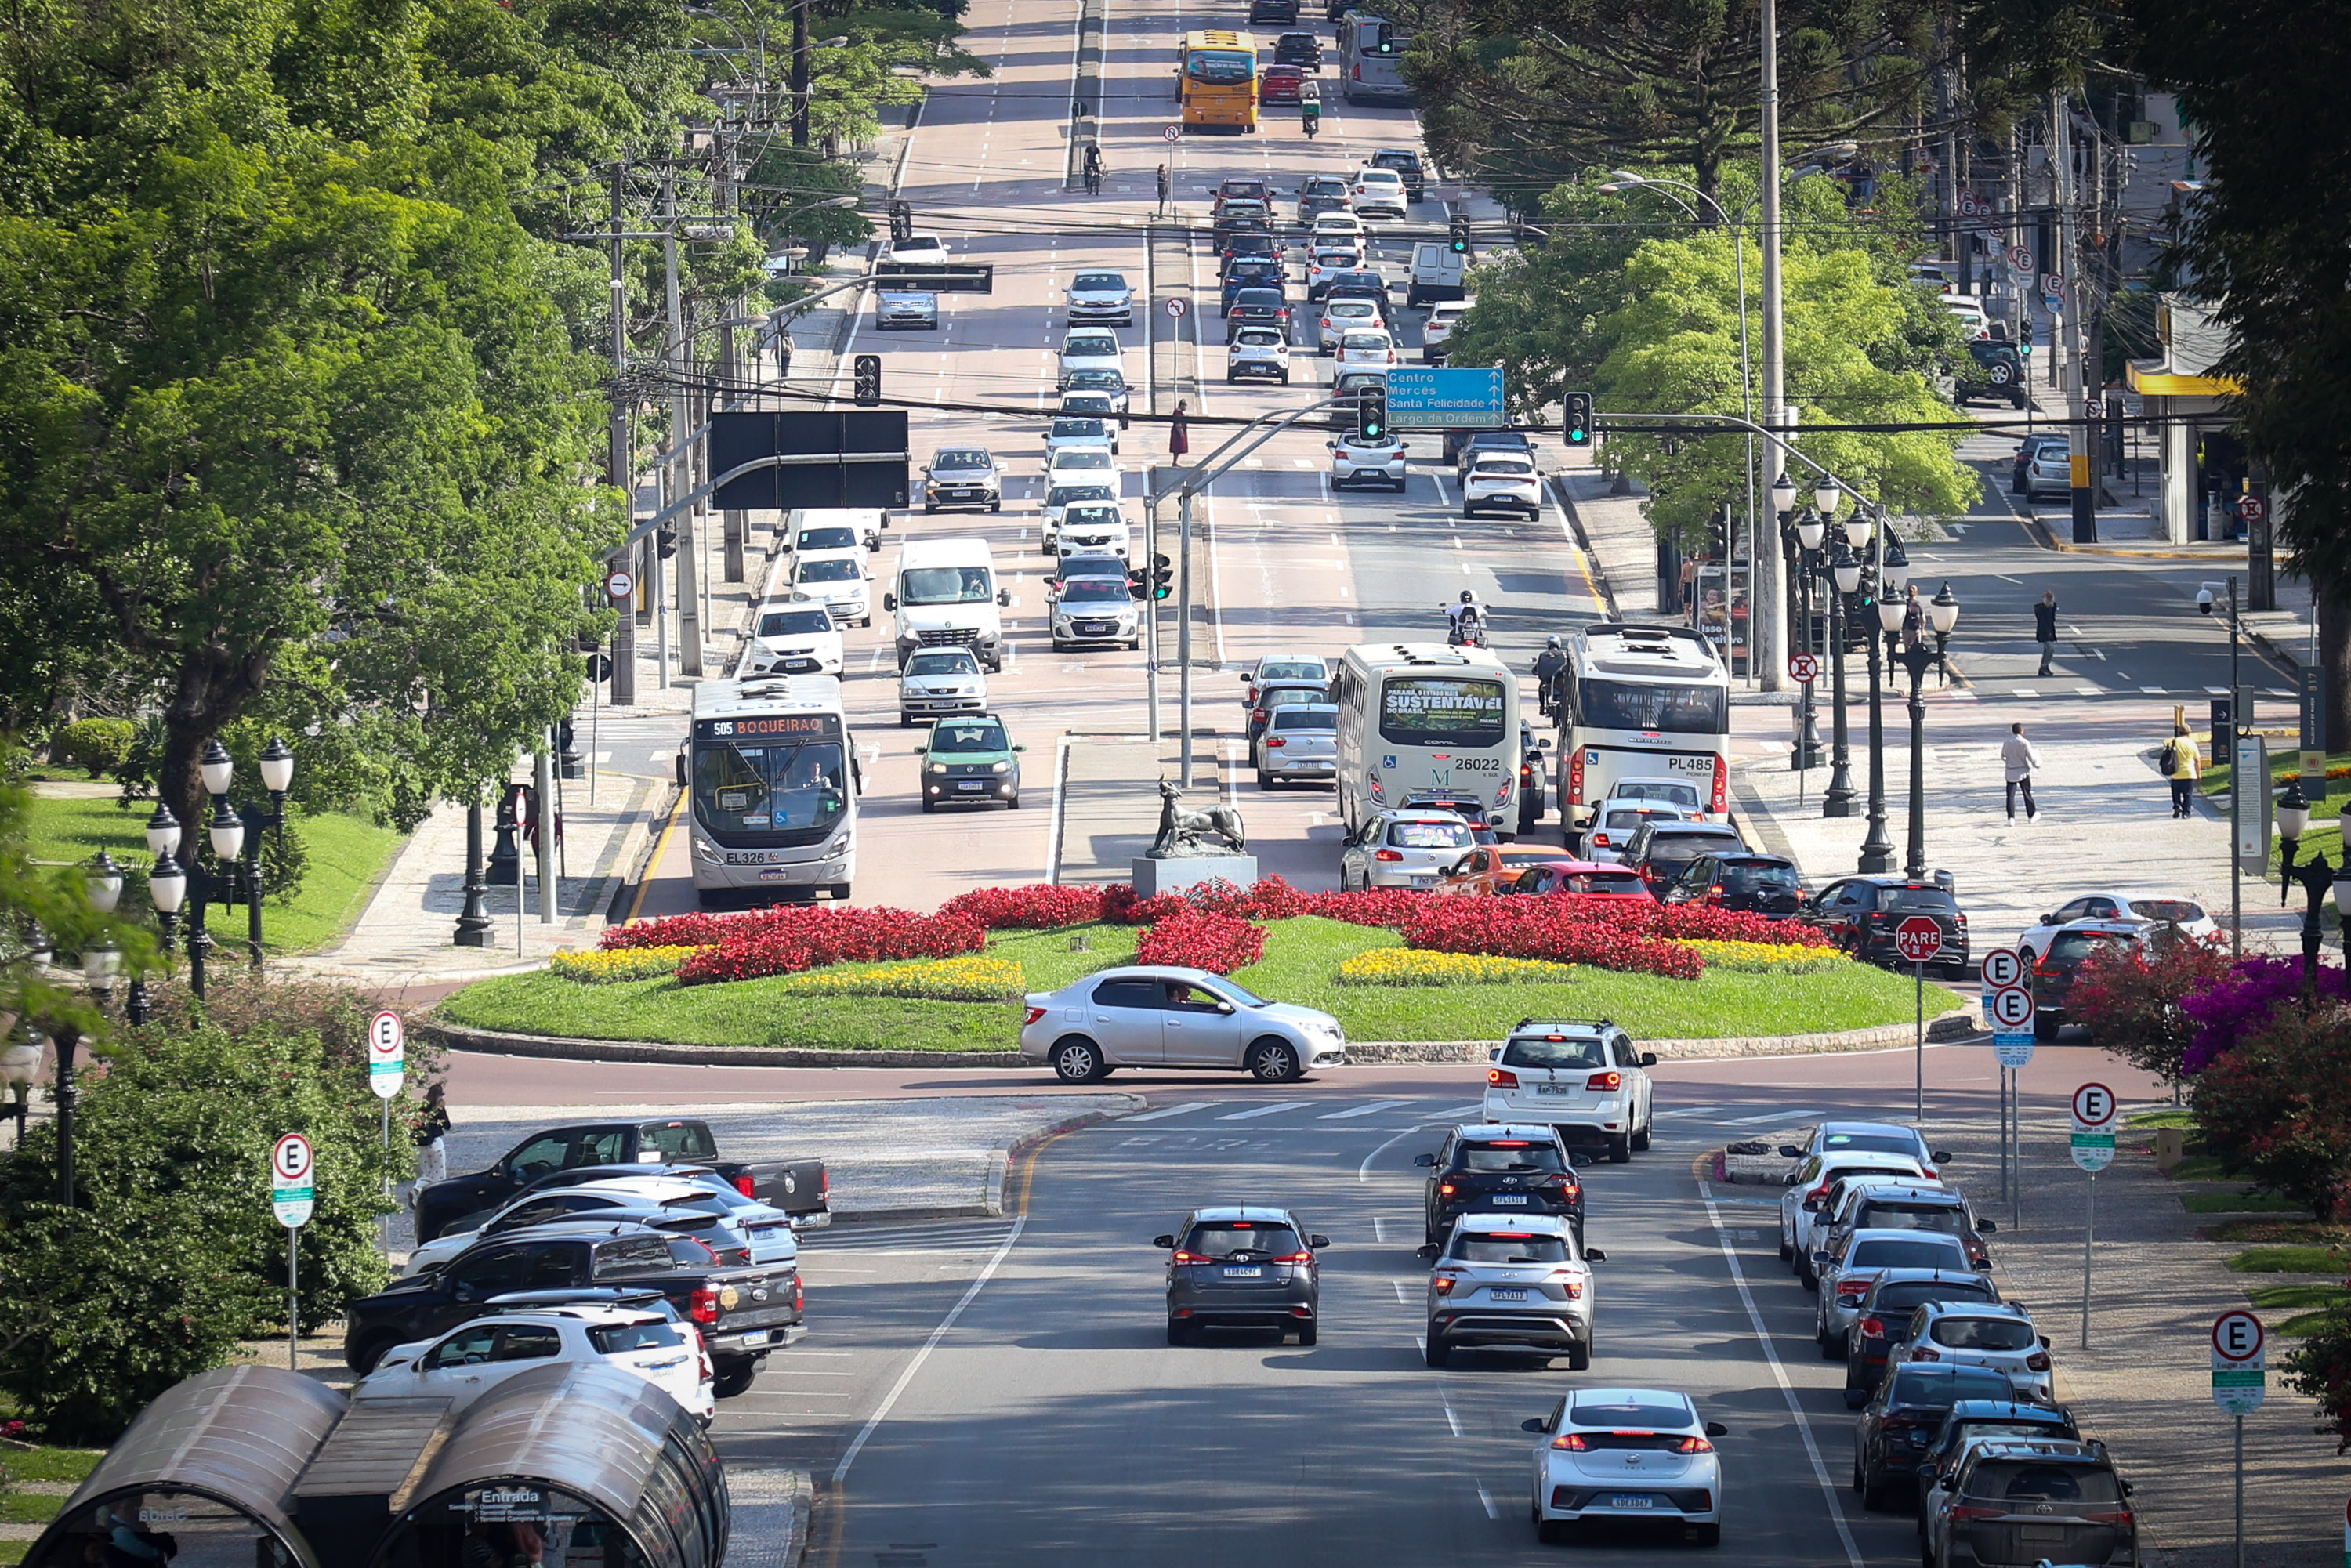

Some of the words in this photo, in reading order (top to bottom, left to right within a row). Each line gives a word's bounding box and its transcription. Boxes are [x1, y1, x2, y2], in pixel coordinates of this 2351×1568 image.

[1965, 203, 1972, 212] E
[2022, 256, 2029, 266] E
[2052, 278, 2059, 288] E
[1389, 372, 1434, 382] Centro
[1389, 385, 1436, 395] Mercês
[1389, 398, 1422, 408] Santa
[1427, 398, 1485, 408] Felicidade
[1388, 414, 1423, 425] Largo
[1428, 414, 1442, 423] da
[1446, 414, 1486, 423] Ordem
[1701, 624, 1722, 633] Isso
[1705, 635, 1744, 644] ositvo
[2307, 673, 2317, 691] 817
[1386, 694, 1503, 710] SUSTENTÁVEL
[714, 722, 733, 735] 505
[737, 718, 820, 734] BOQUEIRAO
[1455, 759, 1500, 770] 26022
[1669, 758, 1712, 770] PL485
[1431, 769, 1450, 786] M
[726, 853, 765, 863] EL326
[1900, 932, 1939, 945] PARE
[1995, 958, 2009, 980] E
[2006, 995, 2020, 1017] E
[382, 1021, 391, 1044] E
[2086, 1092, 2102, 1117] E
[287, 1144, 299, 1169] E
[2229, 1321, 2247, 1349] E
[482, 1490, 538, 1503] Entrada
